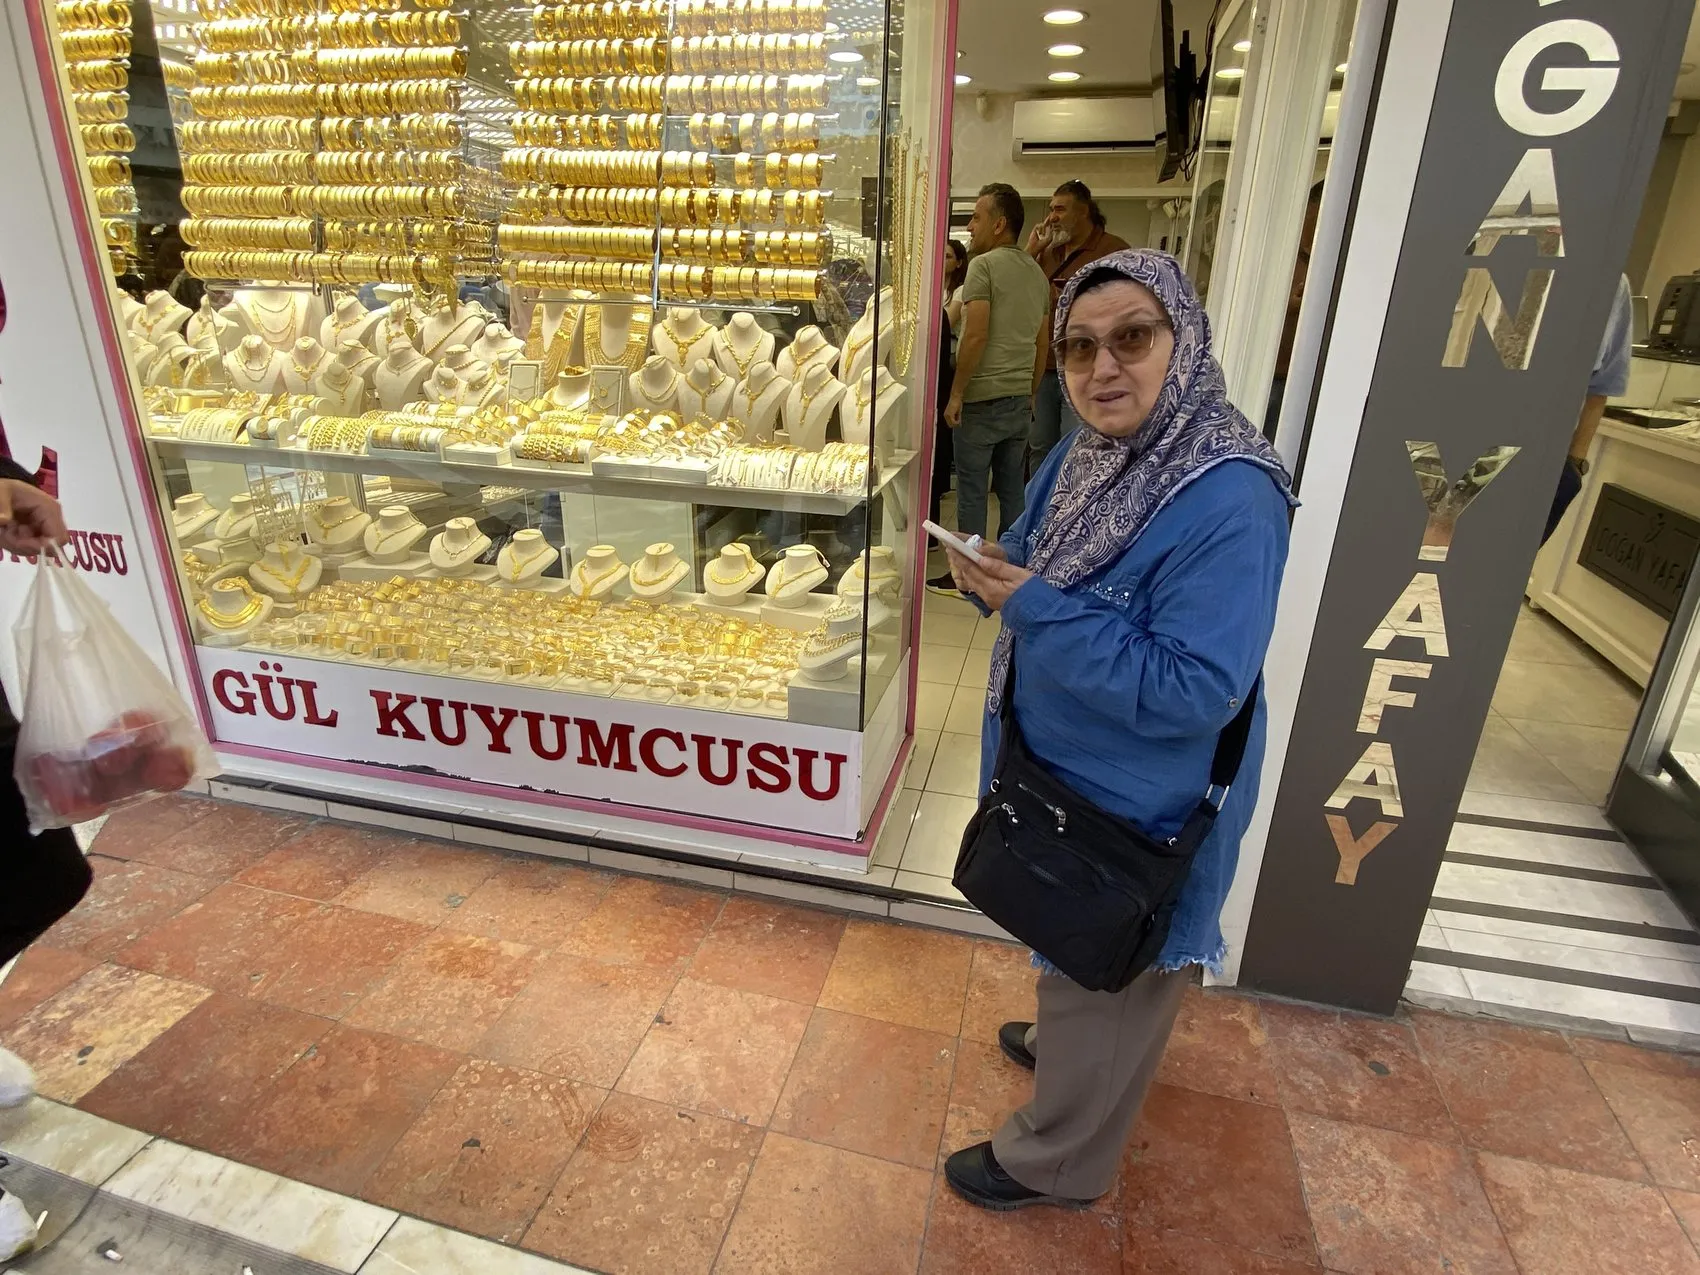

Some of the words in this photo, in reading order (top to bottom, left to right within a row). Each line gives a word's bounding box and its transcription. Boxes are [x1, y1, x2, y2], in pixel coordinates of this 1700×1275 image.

[212, 660, 339, 728] GÜL
[370, 689, 848, 801] KUYUMCUSU
[1323, 440, 1522, 886] YAFAY
